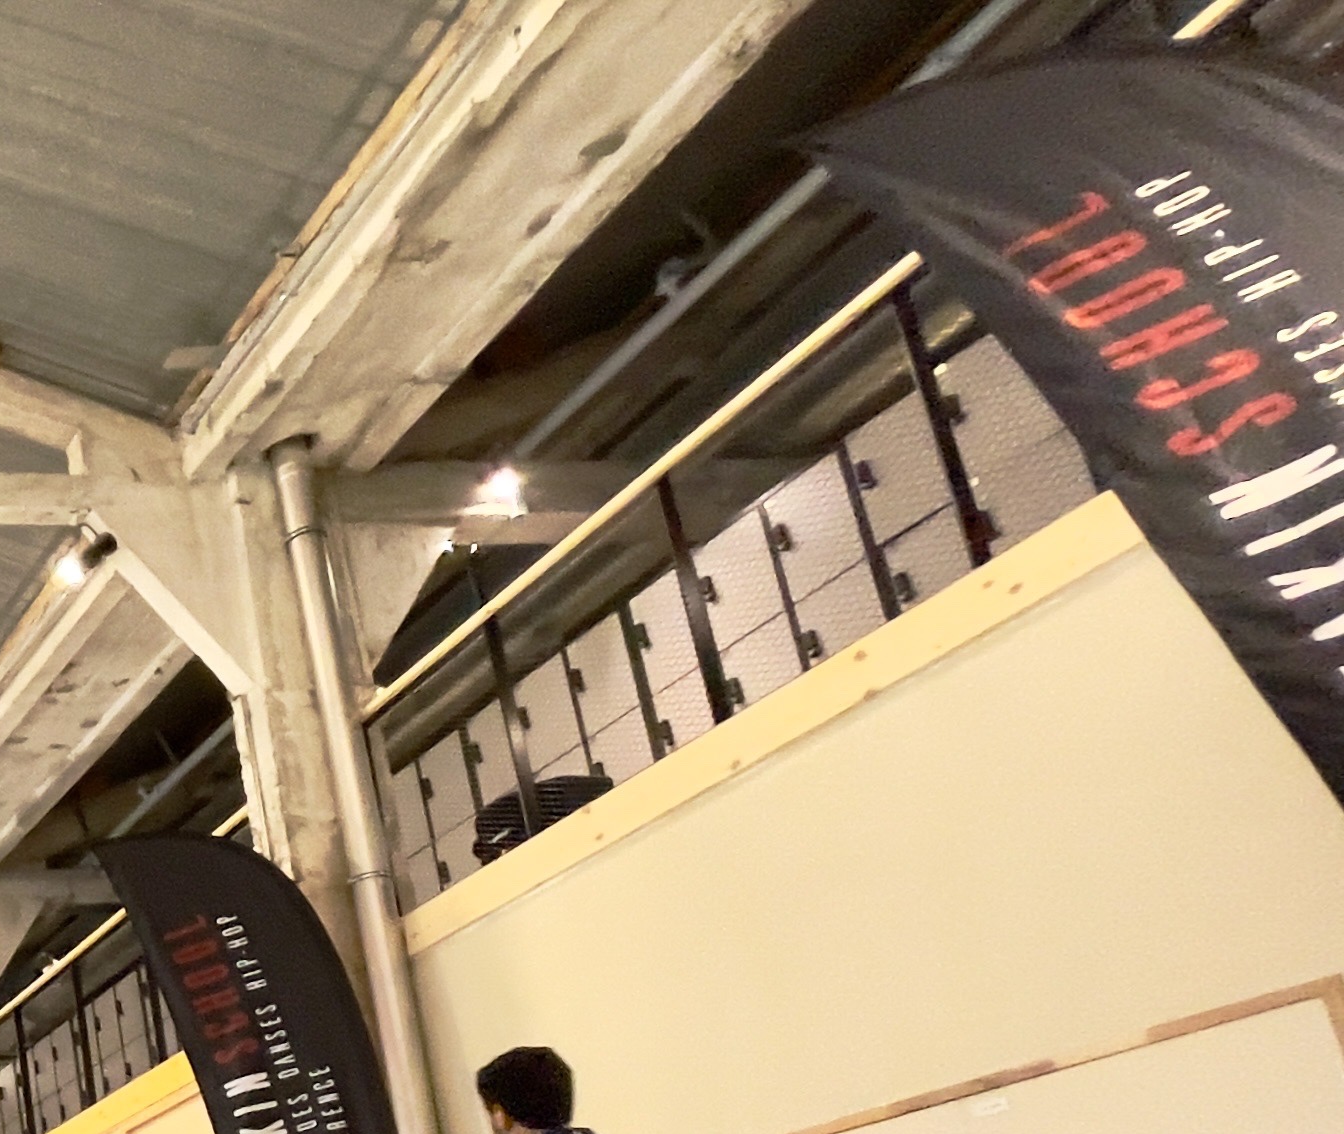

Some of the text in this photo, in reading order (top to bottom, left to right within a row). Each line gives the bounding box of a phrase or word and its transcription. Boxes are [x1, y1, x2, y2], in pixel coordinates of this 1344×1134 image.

[1003, 190, 1299, 457] SCHOOL
[163, 914, 259, 1065] SCHOOL
[216, 915, 268, 991] HIP-HOP
[255, 1003, 300, 1080] DANSES
[286, 1091, 318, 1133] DES
